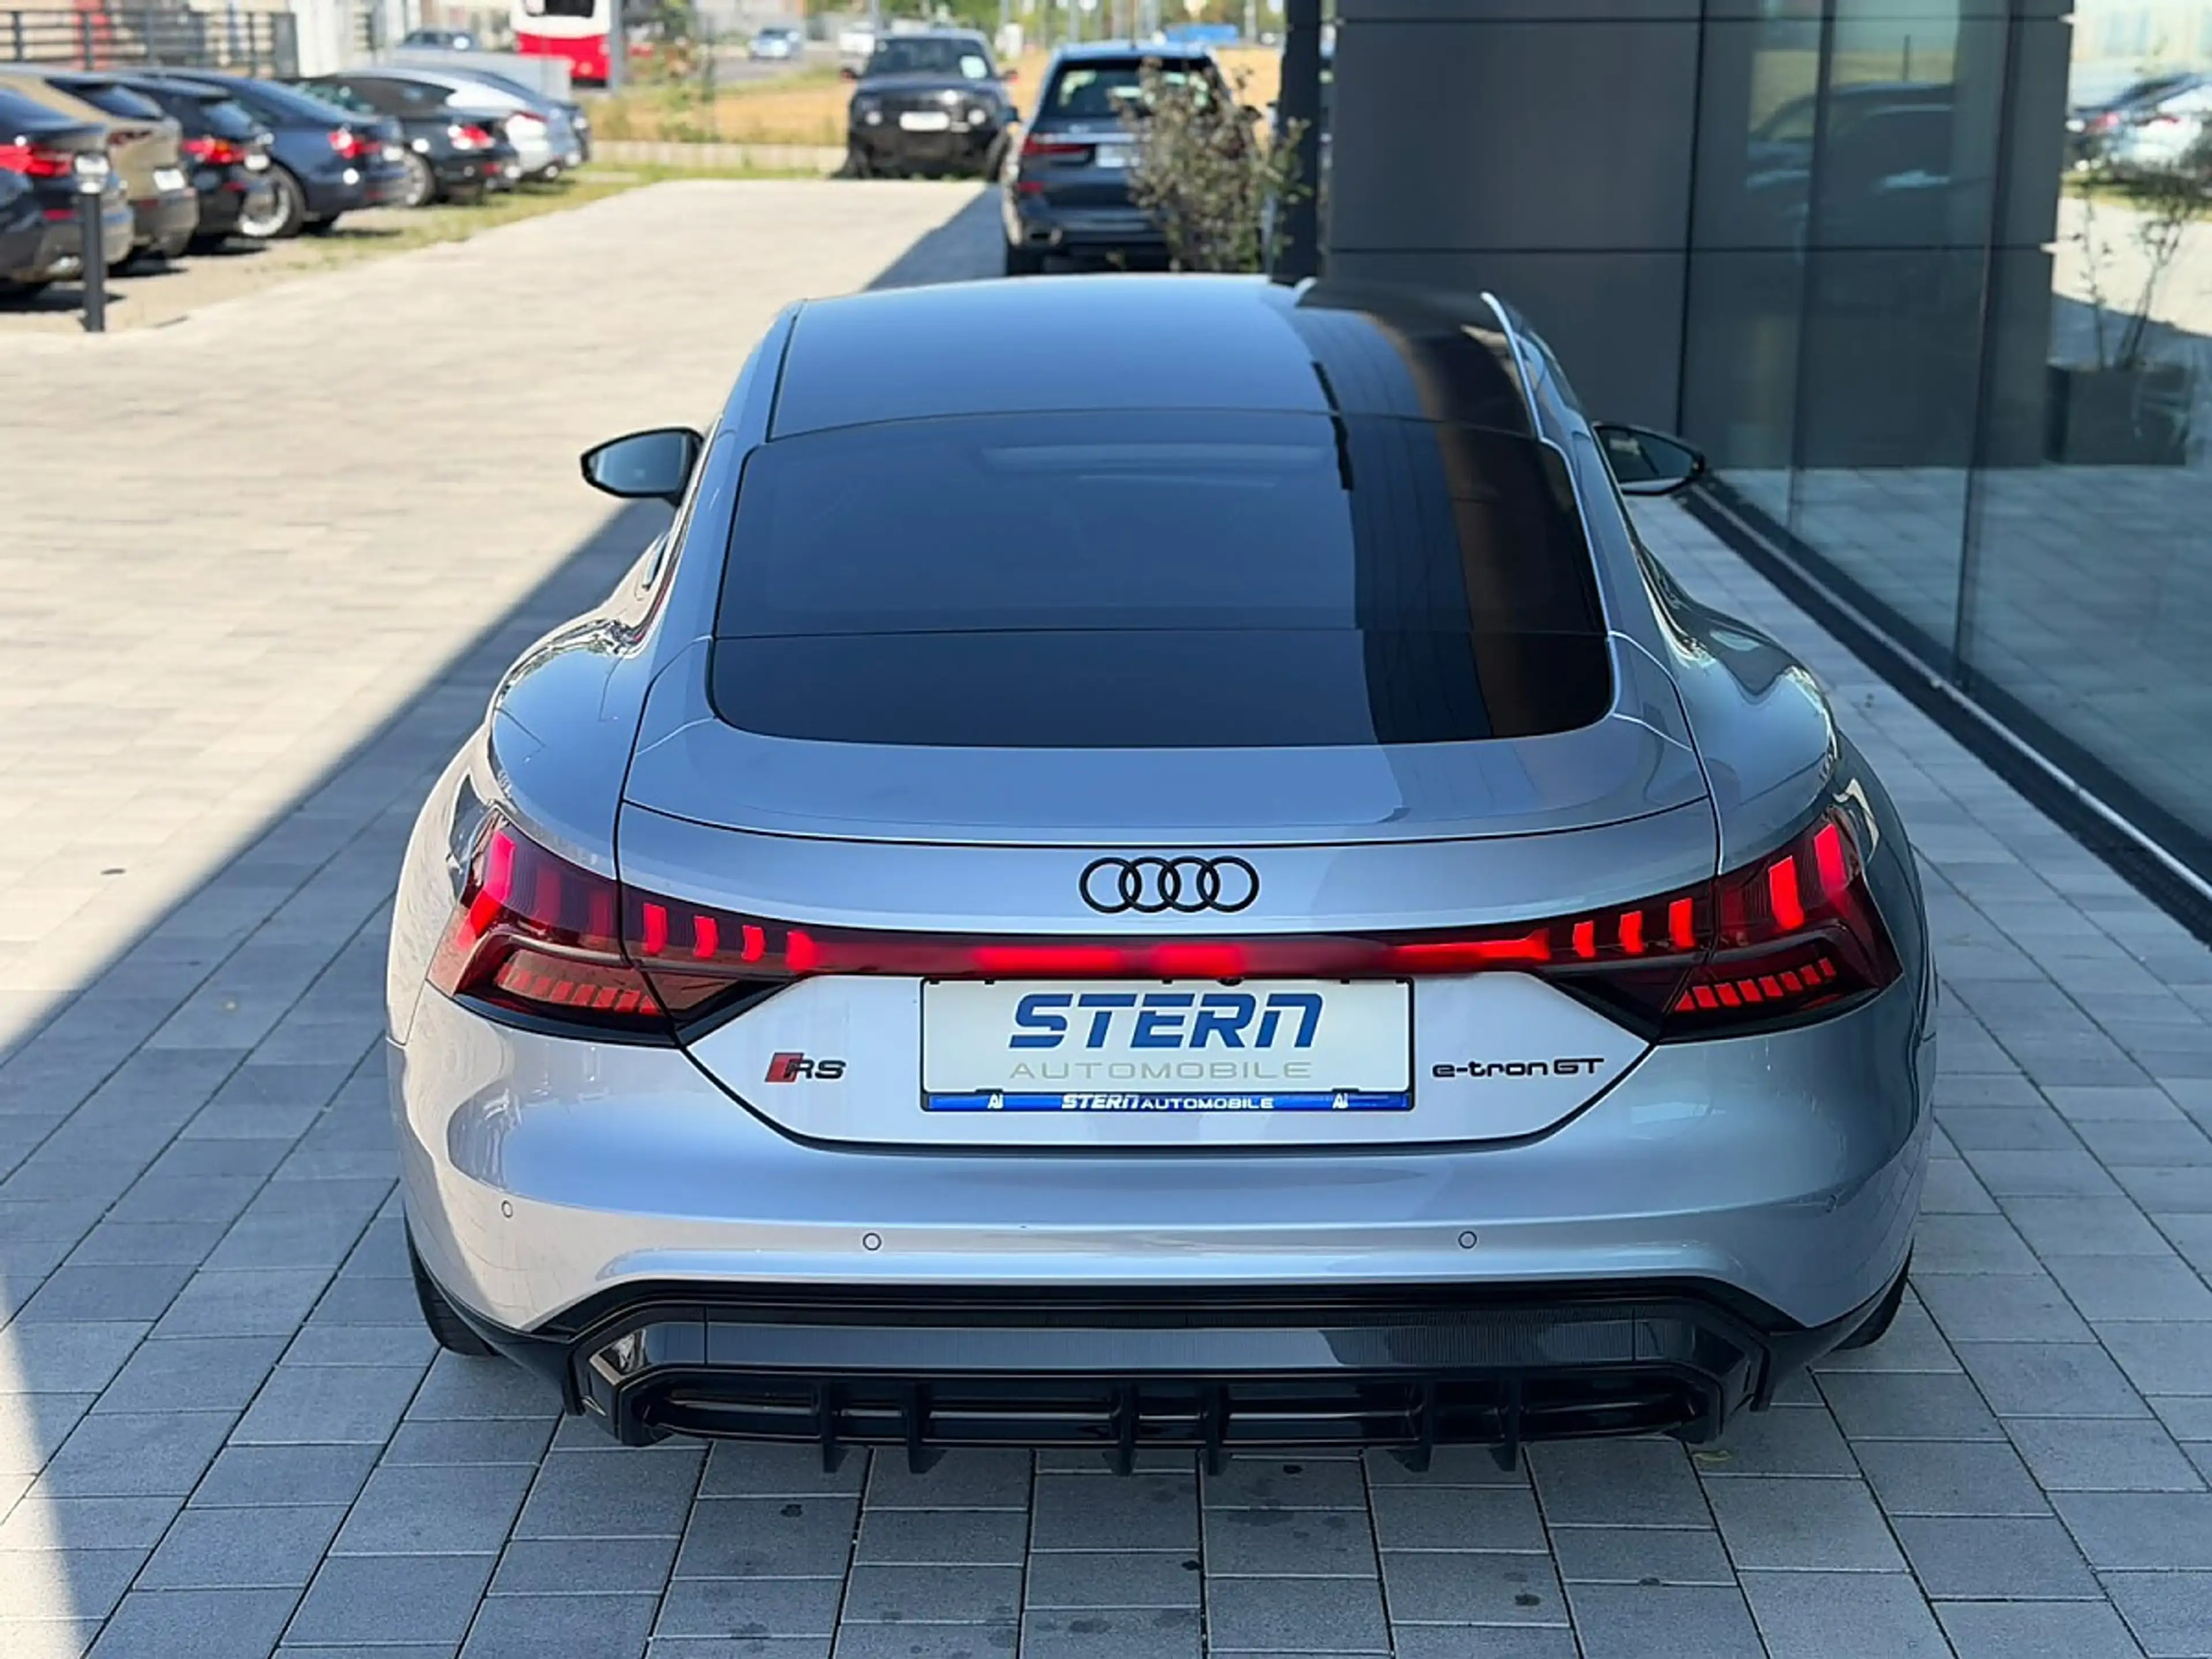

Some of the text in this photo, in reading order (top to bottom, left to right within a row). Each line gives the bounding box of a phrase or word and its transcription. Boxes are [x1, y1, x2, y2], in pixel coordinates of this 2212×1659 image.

[1009, 993, 1323, 1048] STERN
[783, 1059, 847, 1079] RS
[1009, 1062, 1312, 1080] AUTOMOBILE
[1432, 1058, 1605, 1077] e-tron GT
[1062, 1094, 1274, 1109] STERN AUTOMOBILE
